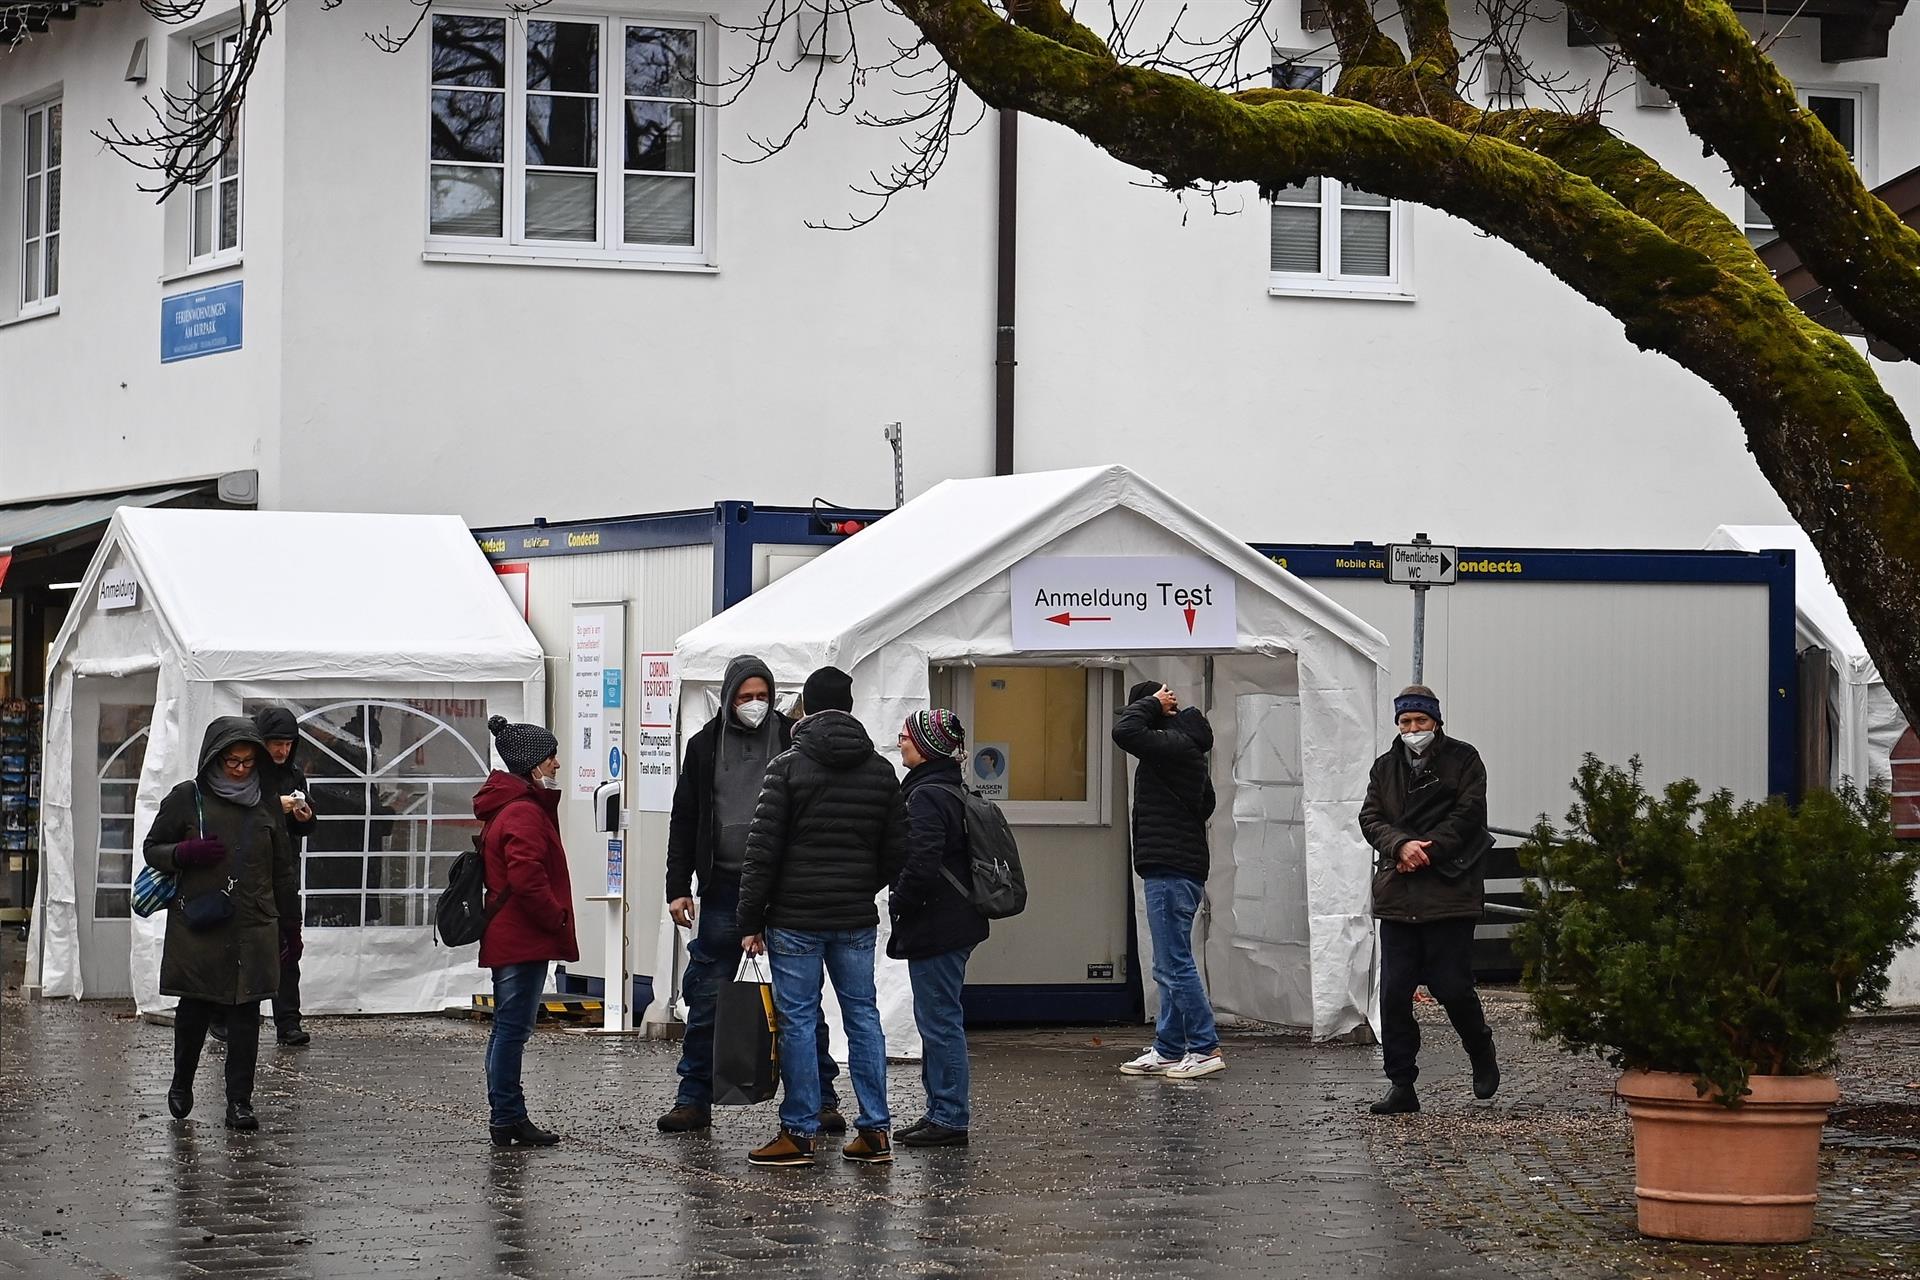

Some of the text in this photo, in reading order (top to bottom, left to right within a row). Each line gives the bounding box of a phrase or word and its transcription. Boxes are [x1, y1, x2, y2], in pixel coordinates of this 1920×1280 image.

[175, 302, 227, 325] FERIENWOHNUNGEN
[184, 320, 217, 339] AM KURPARK
[479, 538, 506, 553] ondecta
[568, 532, 599, 547] Condecta
[1336, 558, 1367, 569] Mobile
[1395, 548, 1439, 564] Öffentliches
[1408, 566, 1422, 579] WC
[1456, 559, 1522, 573] ondecta
[100, 579, 136, 601] Anmeldung
[1035, 582, 1213, 611] Anmeldung Test
[650, 661, 670, 677] CORONA
[579, 765, 596, 778] Corona
[640, 761, 649, 774] Test
[650, 763, 661, 774] ohne
